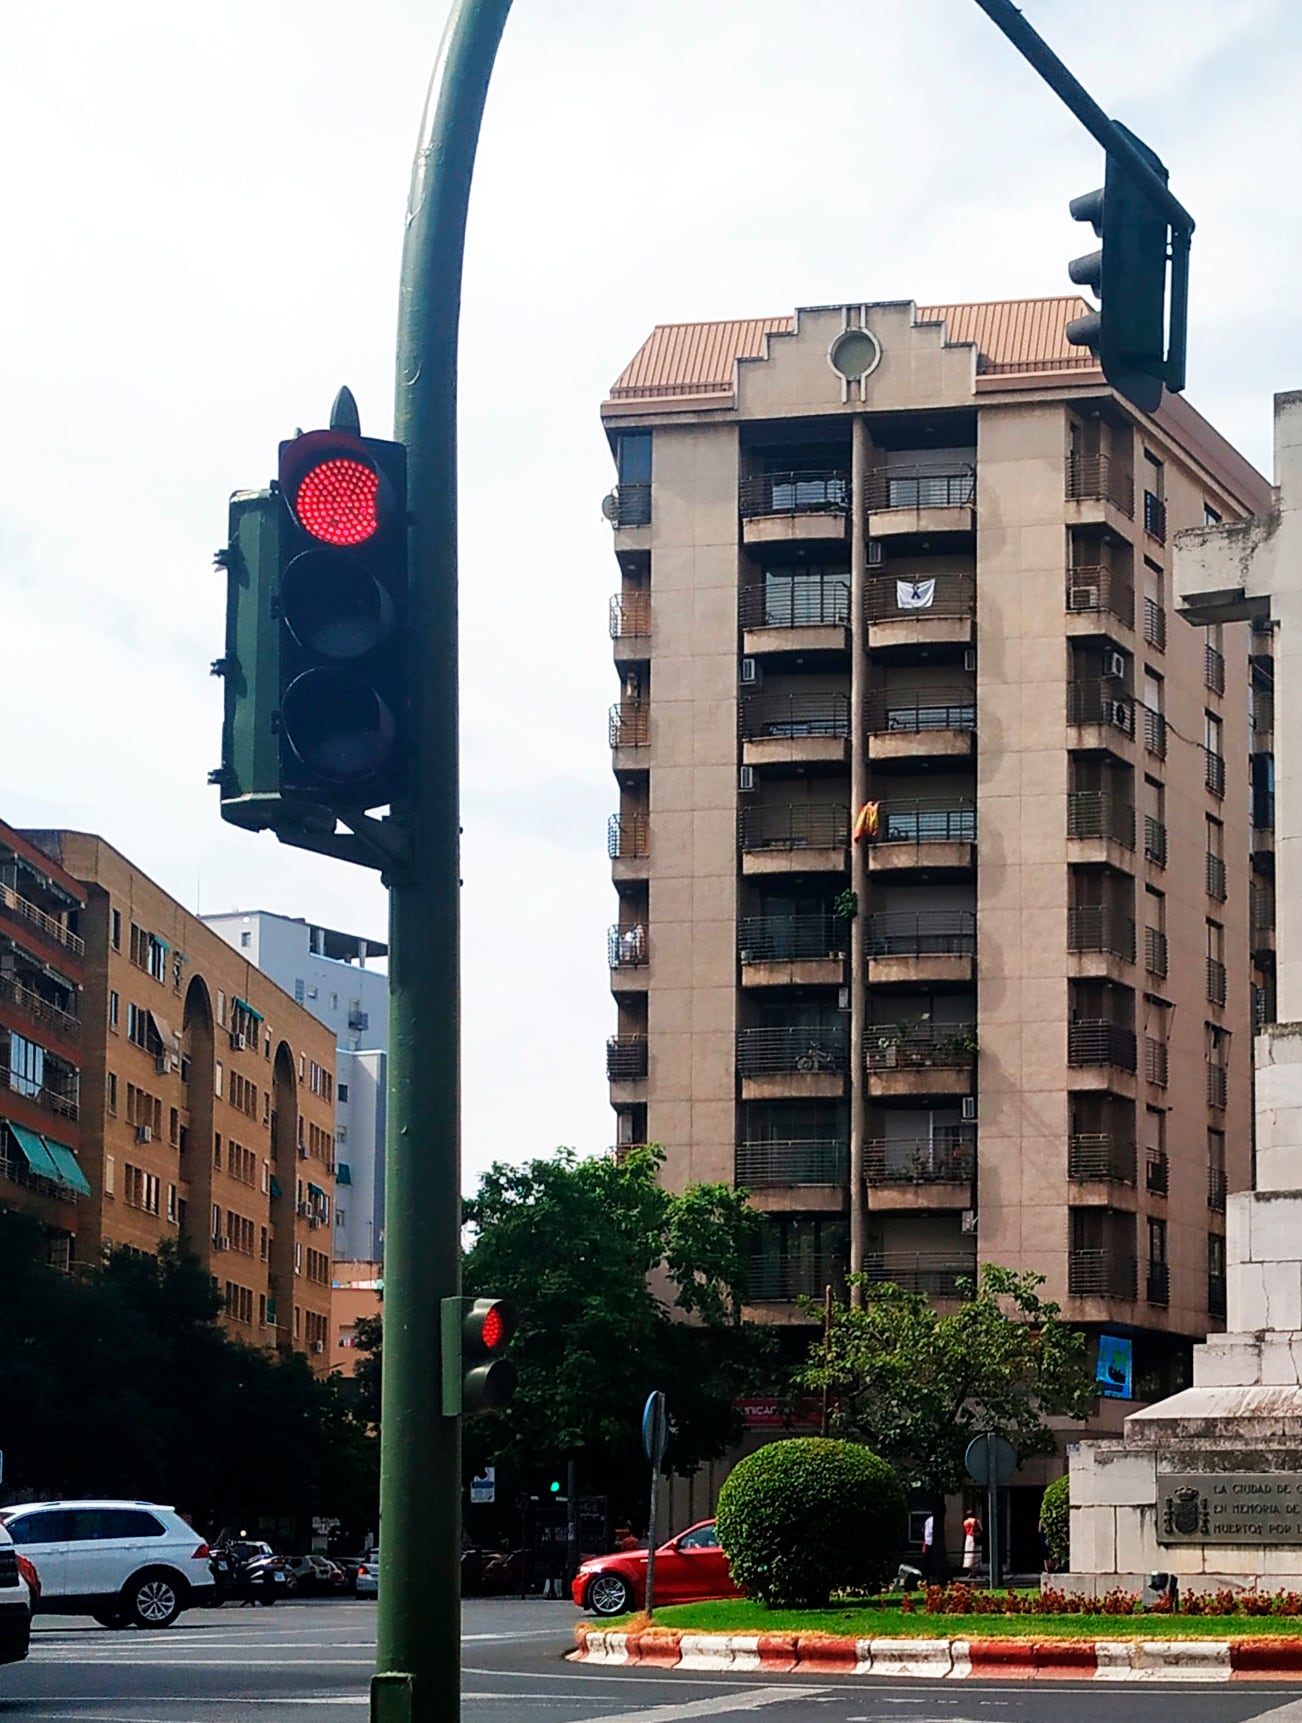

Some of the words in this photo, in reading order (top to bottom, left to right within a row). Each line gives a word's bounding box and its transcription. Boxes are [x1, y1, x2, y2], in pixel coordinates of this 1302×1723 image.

[1213, 1484, 1228, 1495] LA
[1232, 1484, 1272, 1495] CIUDAD
[1277, 1484, 1291, 1495] DE
[1213, 1504, 1228, 1515] EN
[1233, 1504, 1281, 1515] MEMORIA
[1286, 1504, 1300, 1515] DE
[1213, 1524, 1264, 1535] MUERTOS
[1268, 1524, 1292, 1535] POR
